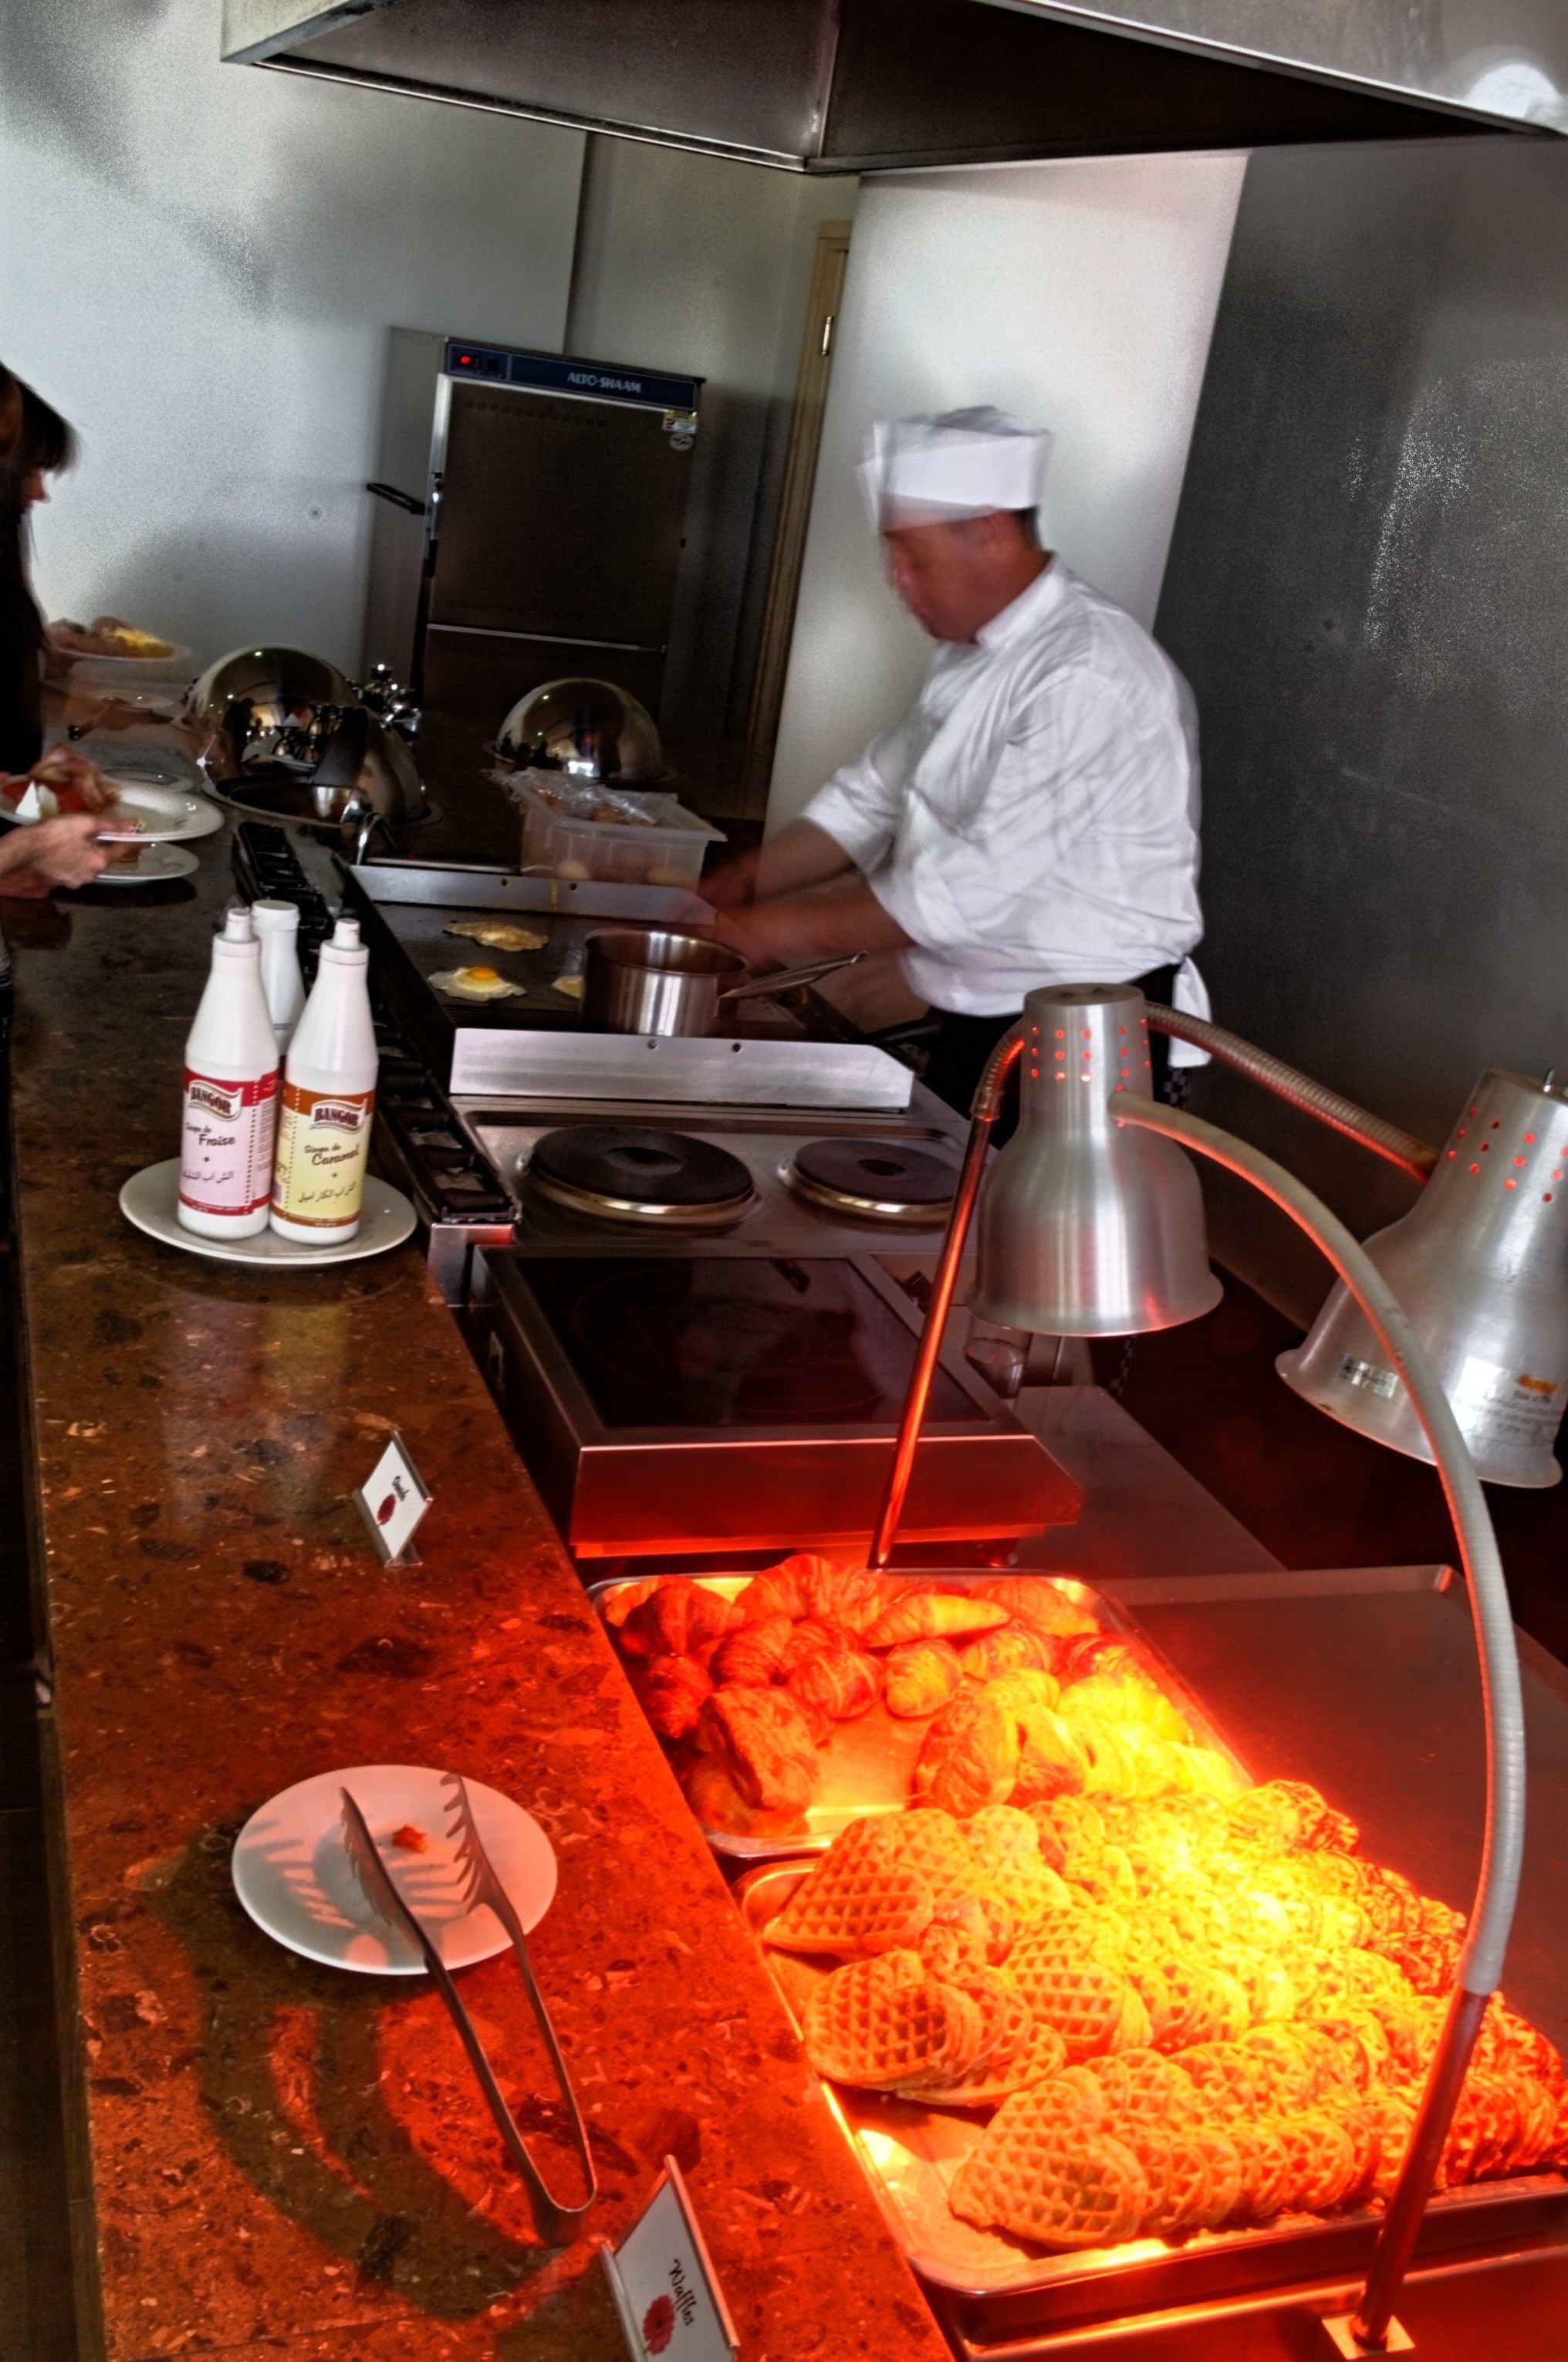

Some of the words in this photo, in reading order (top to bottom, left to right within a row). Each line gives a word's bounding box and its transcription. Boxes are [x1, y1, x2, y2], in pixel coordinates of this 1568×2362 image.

[566, 372, 642, 393] ALTO-SHAAM
[314, 1108, 359, 1126] BANGOR
[198, 1133, 236, 1146] Fraise
[312, 1143, 360, 1166] Caramel
[668, 2259, 697, 2326] Waffles
